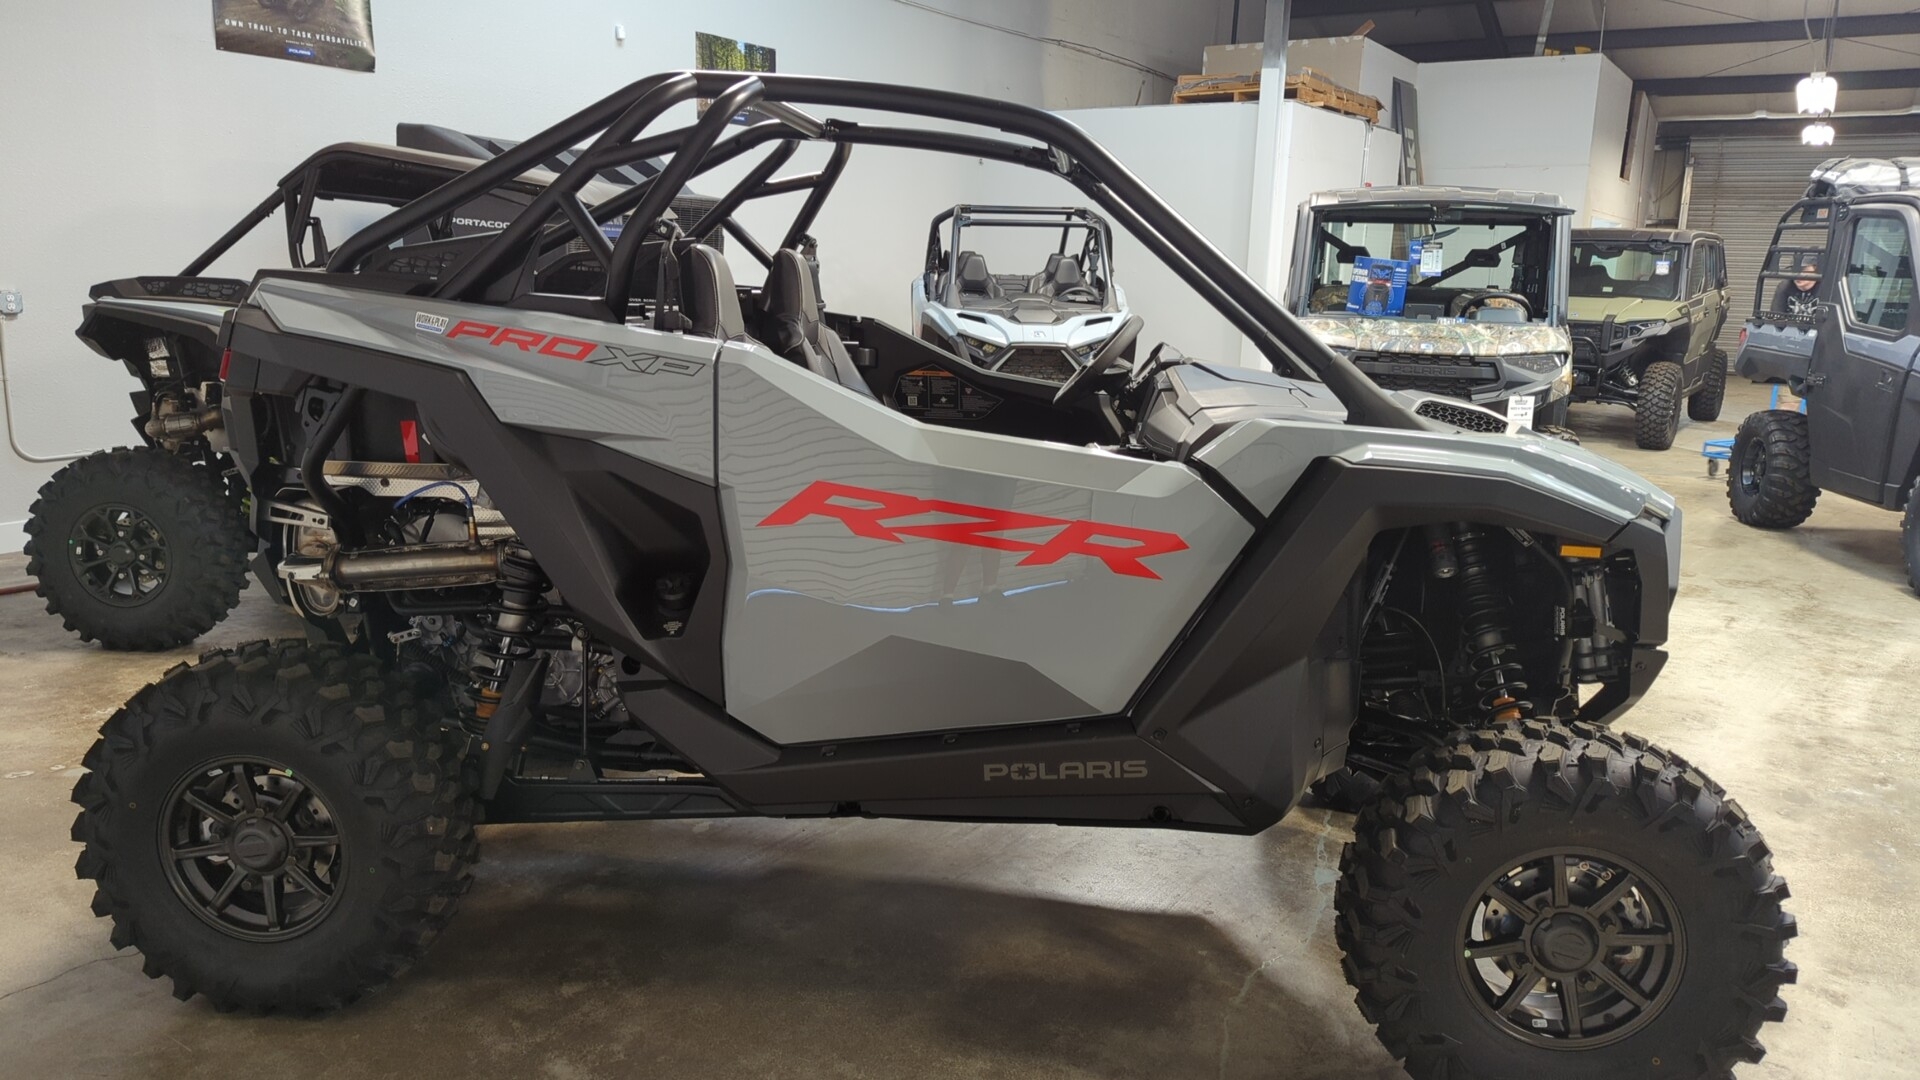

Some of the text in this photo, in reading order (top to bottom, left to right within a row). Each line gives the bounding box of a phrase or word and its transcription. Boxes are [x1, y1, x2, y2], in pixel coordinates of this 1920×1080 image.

[225, 18, 244, 28] OWN
[248, 22, 273, 33] TRAIL
[277, 27, 288, 35] TO
[291, 29, 312, 39] TASK
[315, 34, 368, 47] VERSATILITY
[446, 320, 706, 377] PRO XP
[1391, 364, 1458, 378] POLARIS
[755, 480, 1190, 580] RZR
[983, 760, 1149, 782] POLARIS
